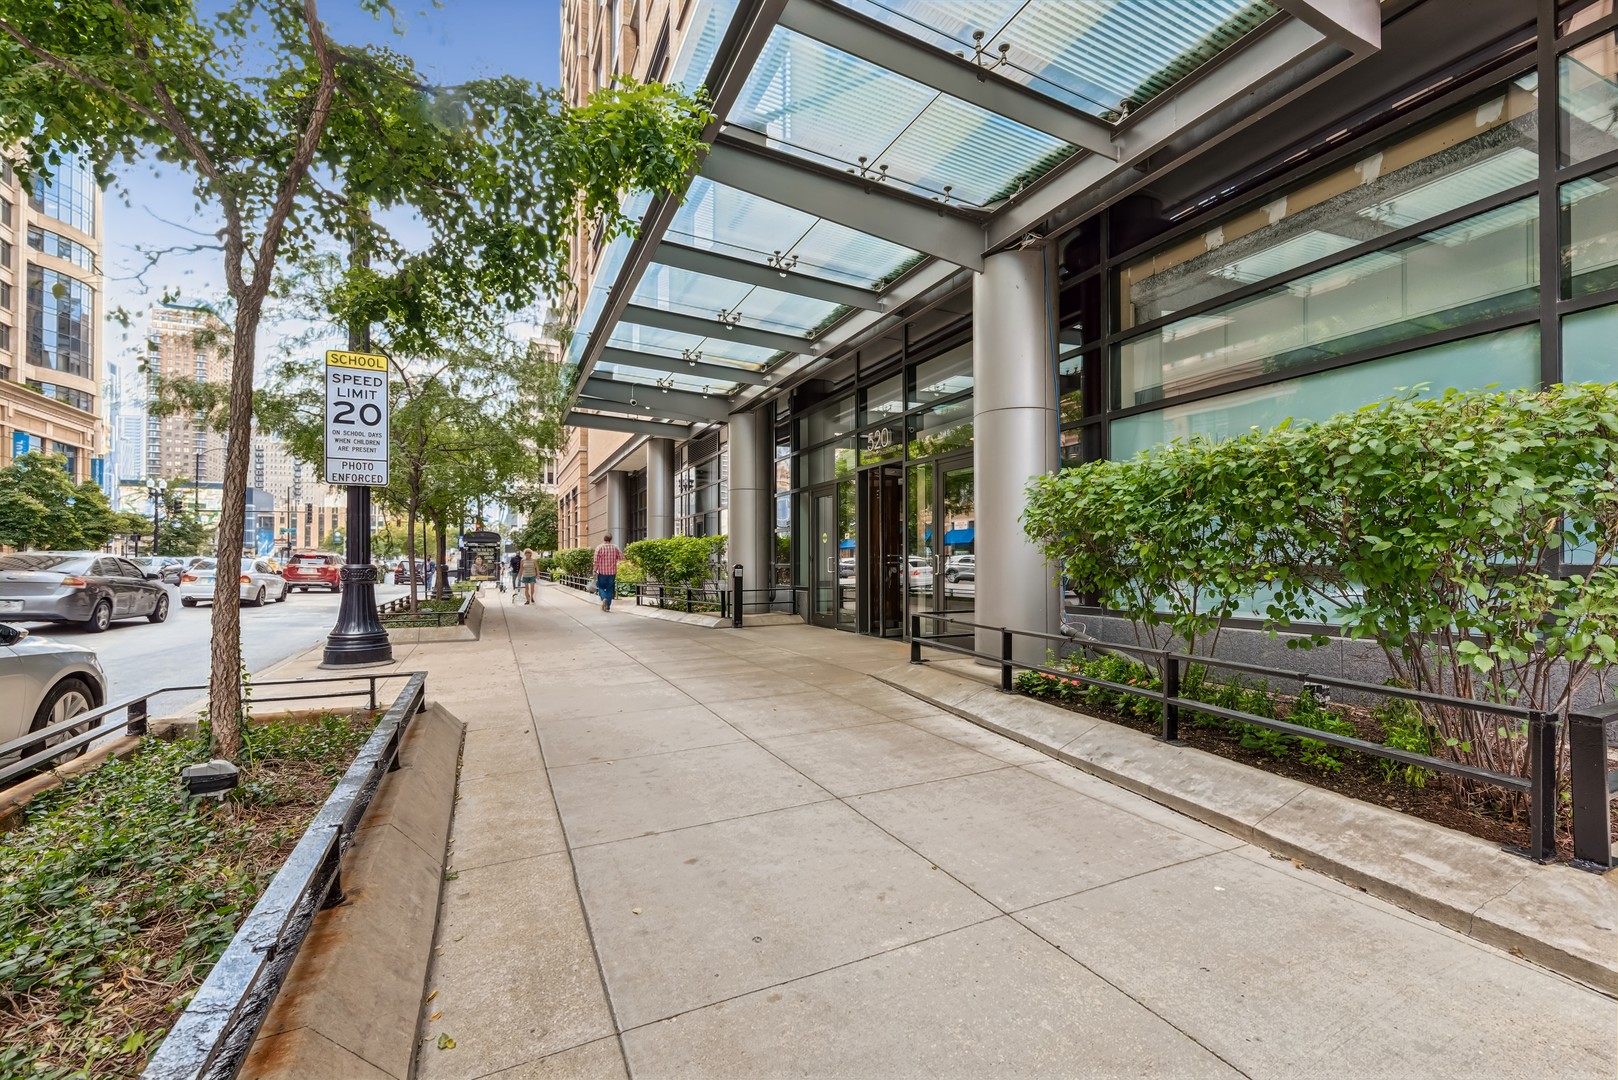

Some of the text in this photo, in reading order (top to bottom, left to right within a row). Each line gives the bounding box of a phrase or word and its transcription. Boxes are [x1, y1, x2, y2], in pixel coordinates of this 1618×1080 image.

[330, 353, 384, 368] SCHOOL
[332, 373, 383, 387] SPEED
[337, 387, 377, 400] LIMIT
[333, 401, 382, 426] 20
[343, 430, 366, 438] SCHOOL
[867, 427, 889, 451] 520
[342, 461, 374, 471] PHOTO
[332, 473, 384, 484] ENFORCED
